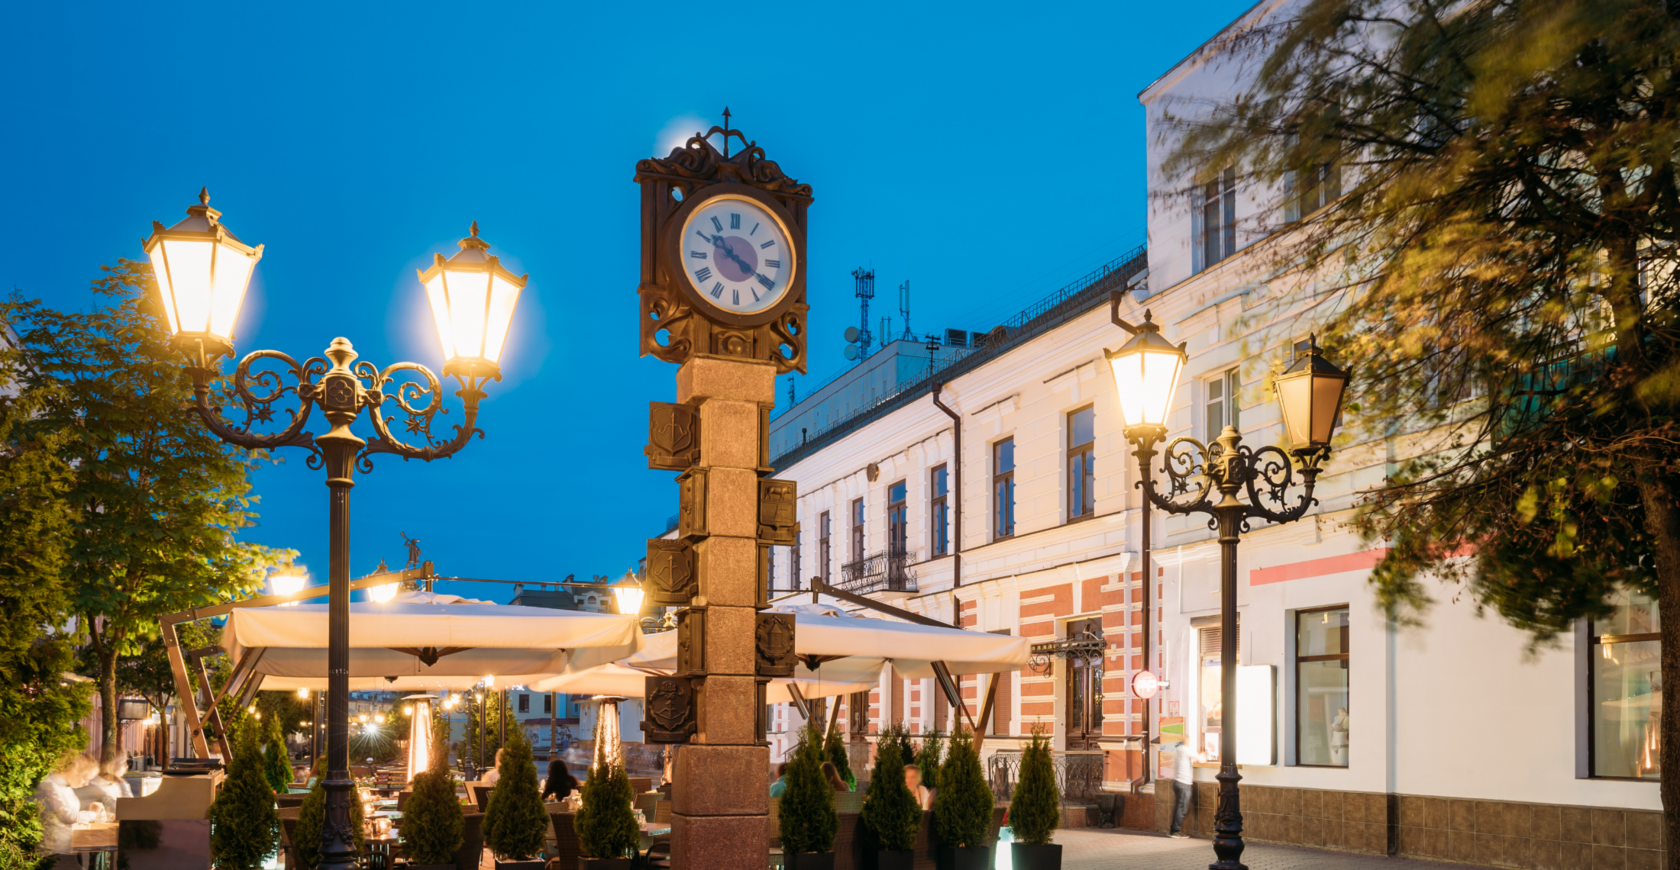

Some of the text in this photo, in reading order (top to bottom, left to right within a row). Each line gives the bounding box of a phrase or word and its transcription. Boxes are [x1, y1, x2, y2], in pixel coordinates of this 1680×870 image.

[710, 216, 723, 233] XI
[731, 213, 740, 229] XII
[696, 230, 712, 243] X
[760, 240, 775, 249] II
[691, 251, 708, 259] IX
[765, 259, 780, 268] III
[695, 267, 712, 283] VIII
[710, 282, 724, 299] VII
[733, 290, 739, 305] VI
[751, 287, 760, 302] V
